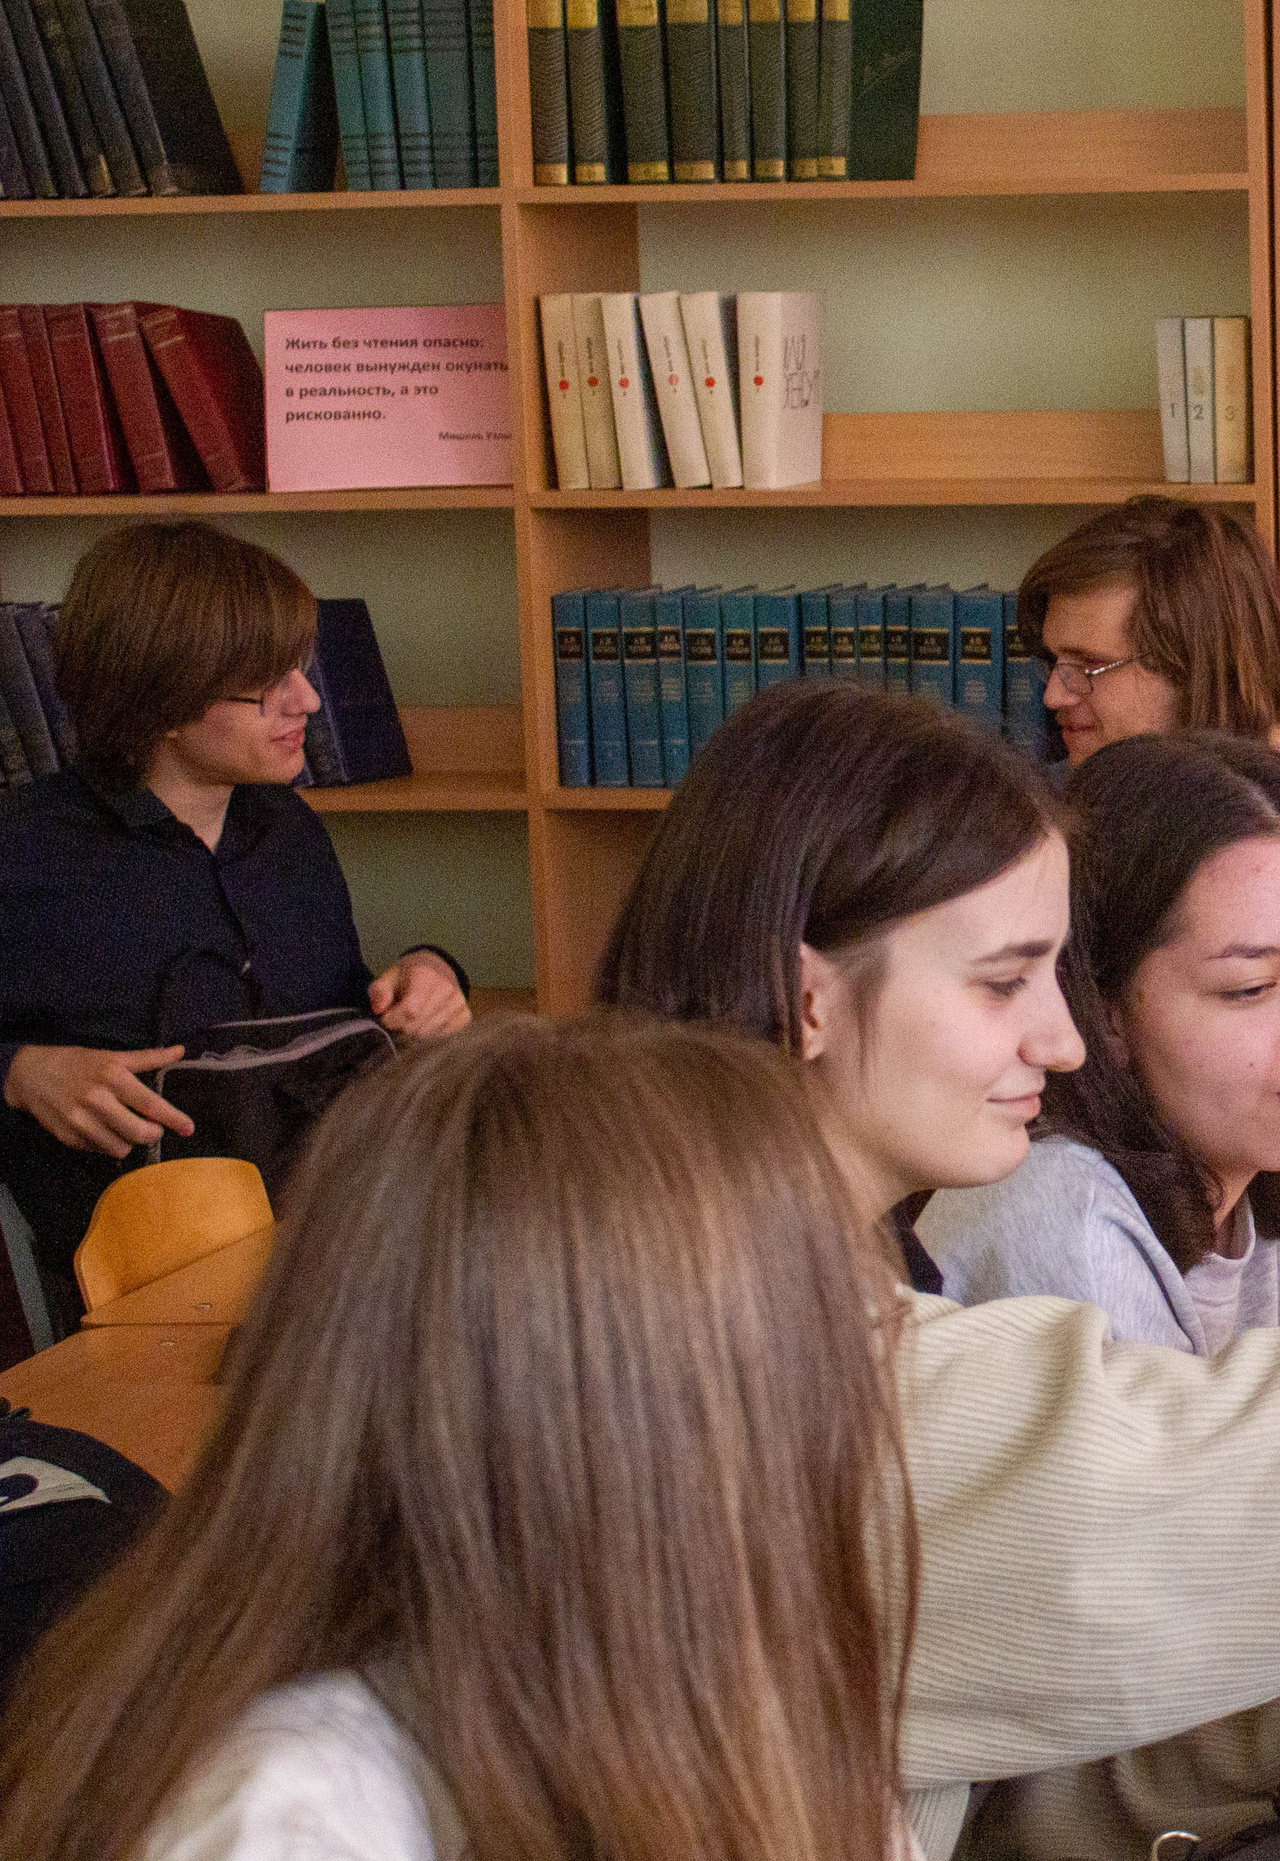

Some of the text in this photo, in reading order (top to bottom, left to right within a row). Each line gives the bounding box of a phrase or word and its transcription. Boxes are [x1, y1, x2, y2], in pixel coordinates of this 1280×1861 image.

[285, 336, 484, 350] Жить без чтения опасно:
[285, 362, 351, 374] человек
[355, 360, 441, 374] вынужден
[285, 385, 439, 399] в реальность, а это
[285, 407, 387, 424] рискованно.
[1169, 402, 1176, 418] 1
[1193, 404, 1204, 421] 2
[1224, 405, 1235, 421] 3
